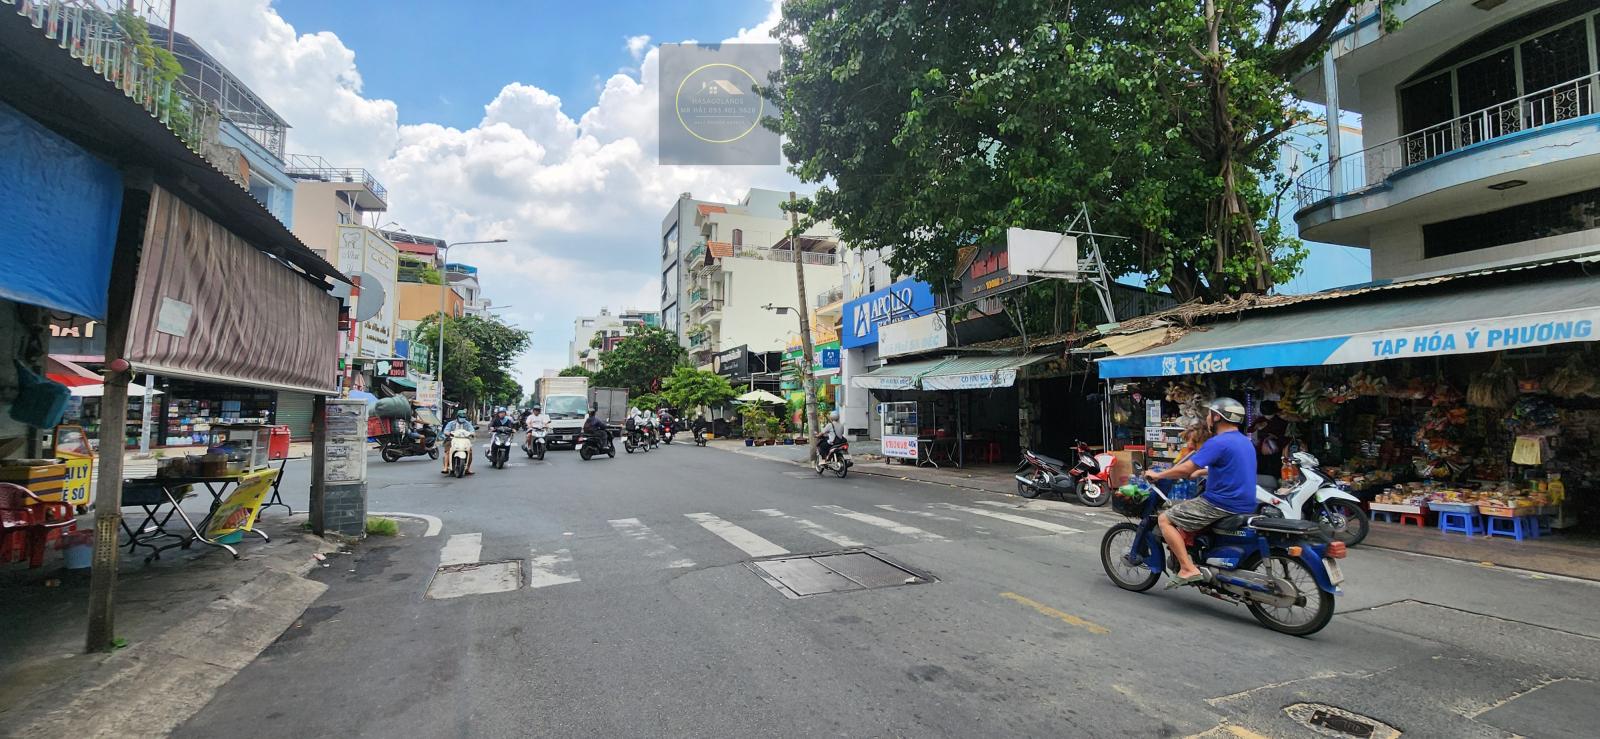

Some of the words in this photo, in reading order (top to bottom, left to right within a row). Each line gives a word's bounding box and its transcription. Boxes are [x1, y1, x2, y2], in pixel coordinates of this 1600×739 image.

[871, 287, 913, 320] APOLLO
[1372, 337, 1407, 360] TẠP
[1413, 330, 1456, 352] HÓA
[1465, 327, 1480, 349] Ý
[1488, 319, 1593, 348] PHƯƠNG
[1180, 353, 1231, 374] Tiger
[64, 466, 75, 482] ẠI
[72, 482, 85, 501] SỐ
